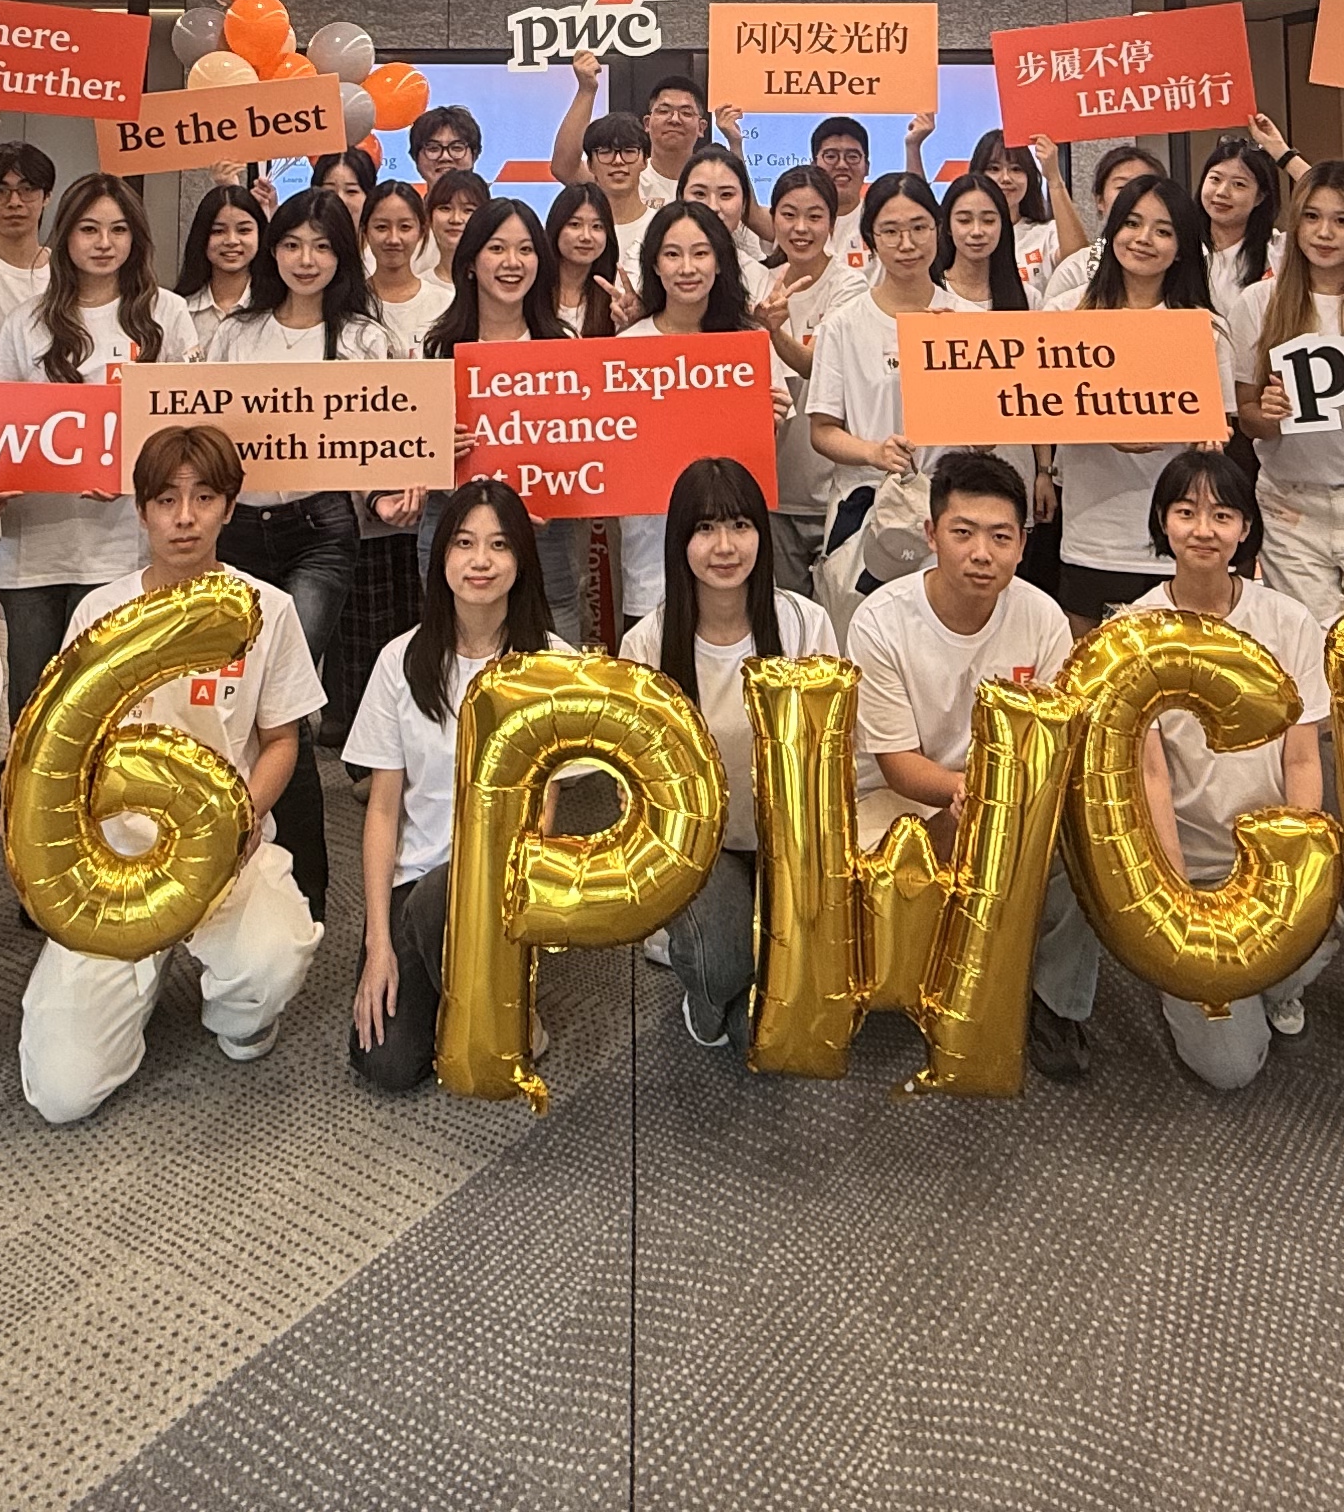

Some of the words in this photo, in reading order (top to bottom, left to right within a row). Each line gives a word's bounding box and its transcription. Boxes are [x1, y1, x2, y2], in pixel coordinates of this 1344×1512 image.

[514, 5, 656, 67] pwc
[735, 21, 909, 56] 闪闪发光的
[1014, 40, 1155, 87] 步履不停
[763, 69, 881, 97] LEAPer
[1077, 71, 1234, 118] LEAP前行
[117, 119, 167, 153] Be
[175, 112, 239, 148] the
[247, 104, 328, 140] best
[922, 339, 1026, 371] LEAP
[1037, 335, 1116, 370] into
[467, 365, 591, 400] Learn,
[602, 355, 755, 401] Explore
[150, 389, 234, 416] LEAP
[241, 387, 315, 415] with
[323, 385, 418, 421] pride.
[997, 382, 1065, 418] the
[1074, 381, 1202, 417] future
[474, 409, 638, 448] Advance
[235, 433, 309, 462] with
[317, 434, 436, 467] impact.
[517, 461, 605, 498] PwC
